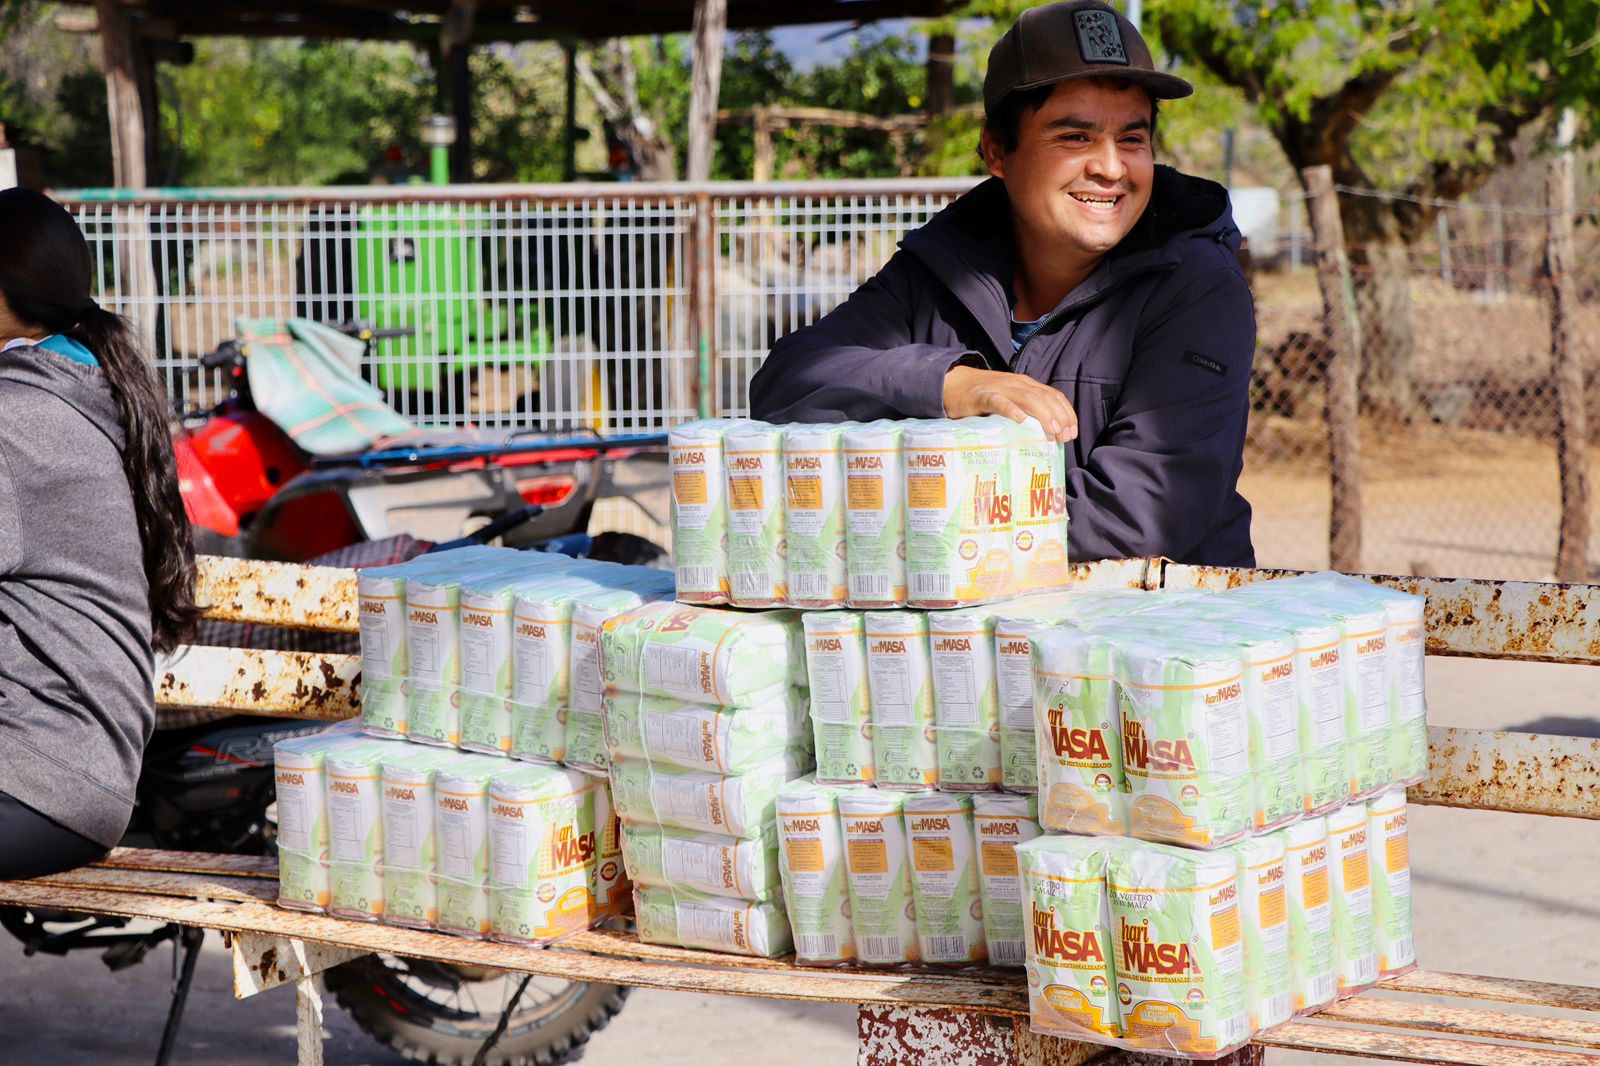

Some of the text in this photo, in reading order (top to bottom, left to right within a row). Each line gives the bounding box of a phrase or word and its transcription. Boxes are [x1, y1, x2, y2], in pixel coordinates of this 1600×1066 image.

[1030, 466, 1051, 489] hari
[999, 642, 1029, 654] hariMAS
[1356, 636, 1386, 655] hariMASA
[1310, 648, 1340, 668] hariMASA
[1261, 662, 1293, 682] hariMASA
[1205, 683, 1241, 705] hariMASA
[1124, 736, 1197, 772] MASA
[911, 818, 950, 831] hariMASA
[981, 822, 1019, 835] hariMASA
[1119, 893, 1152, 902] NUESTRO
[1127, 899, 1148, 909] MAÍZ
[1032, 901, 1055, 930] hari
[1121, 916, 1149, 943] hari
[1034, 925, 1104, 961] MASA
[1122, 941, 1202, 974] MASA
